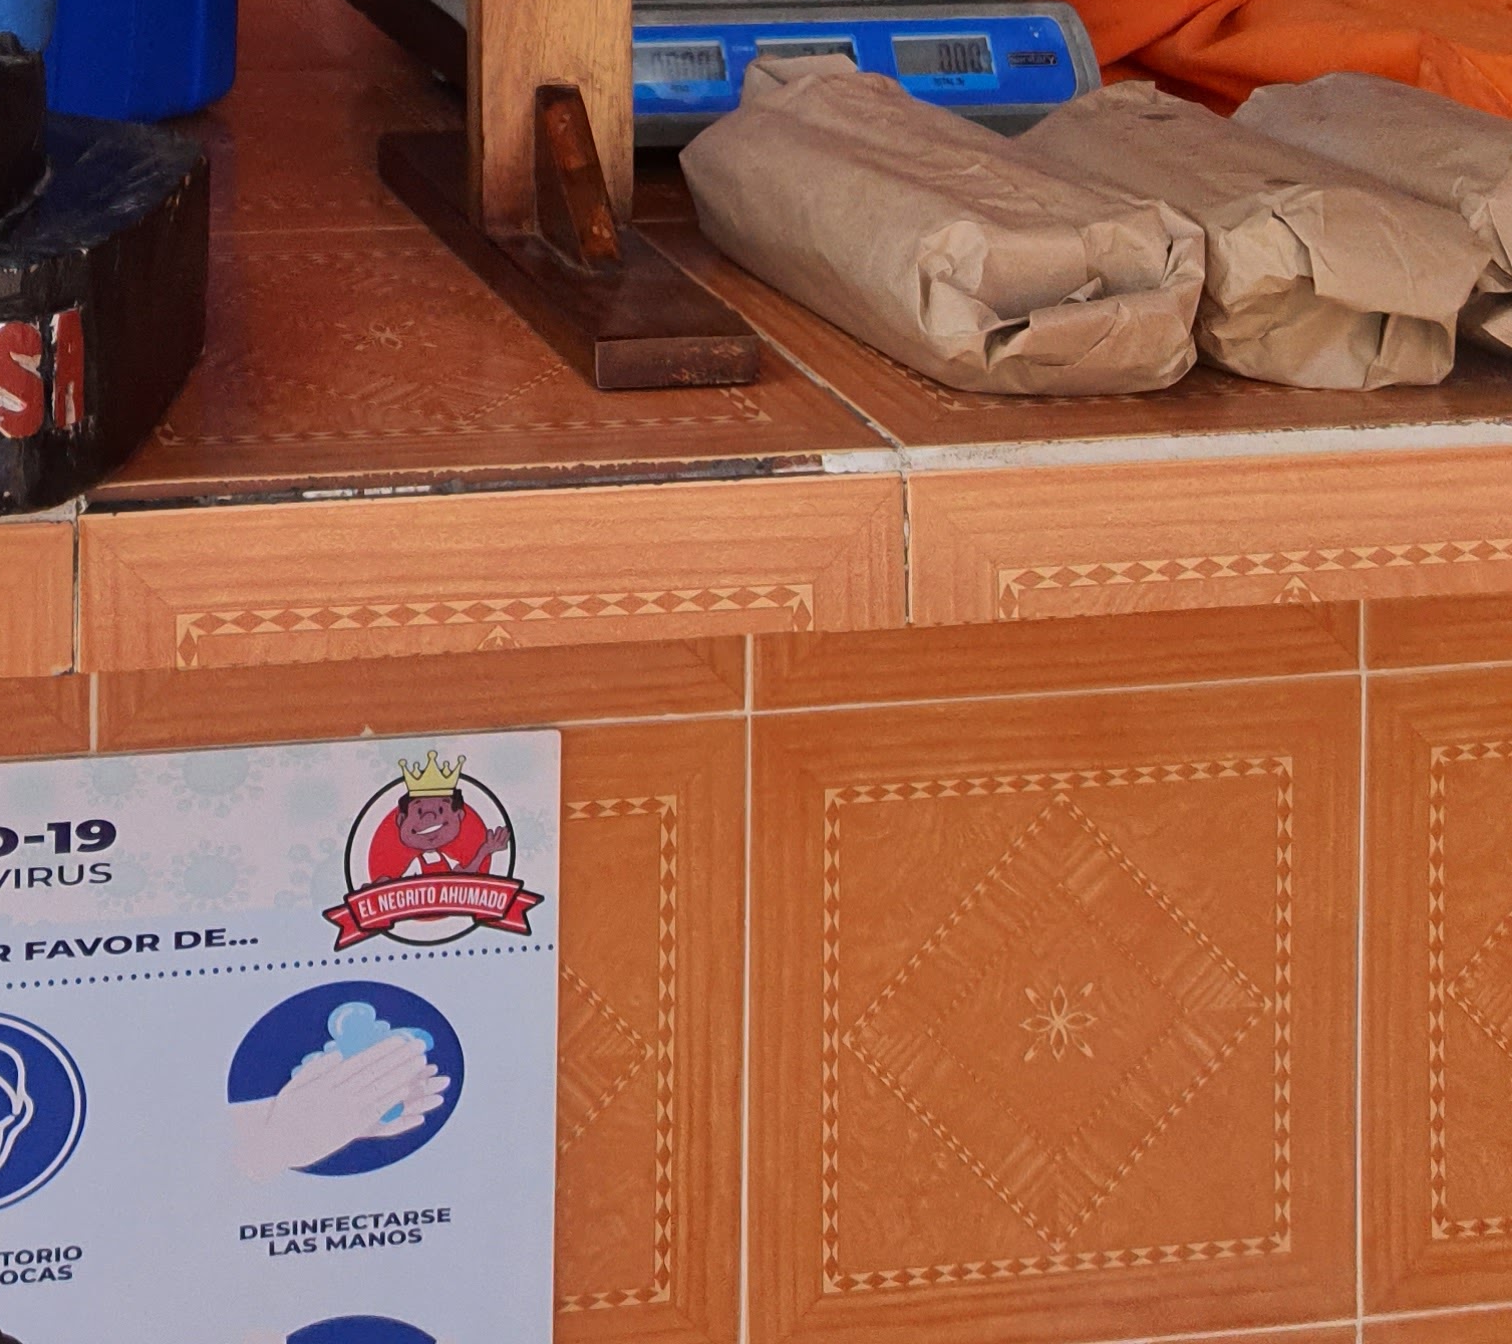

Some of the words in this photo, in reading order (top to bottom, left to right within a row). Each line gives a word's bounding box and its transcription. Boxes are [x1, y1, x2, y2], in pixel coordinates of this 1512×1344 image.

[357, 899, 378, 919] EL
[378, 886, 436, 912] NEGRITO
[439, 885, 508, 911] AHUMADO
[24, 933, 161, 962] FAVOR
[174, 927, 259, 951] DE...
[239, 1207, 452, 1241] DESINFECTARSE
[268, 1236, 318, 1257] LAS
[325, 1227, 423, 1252] MANOS
